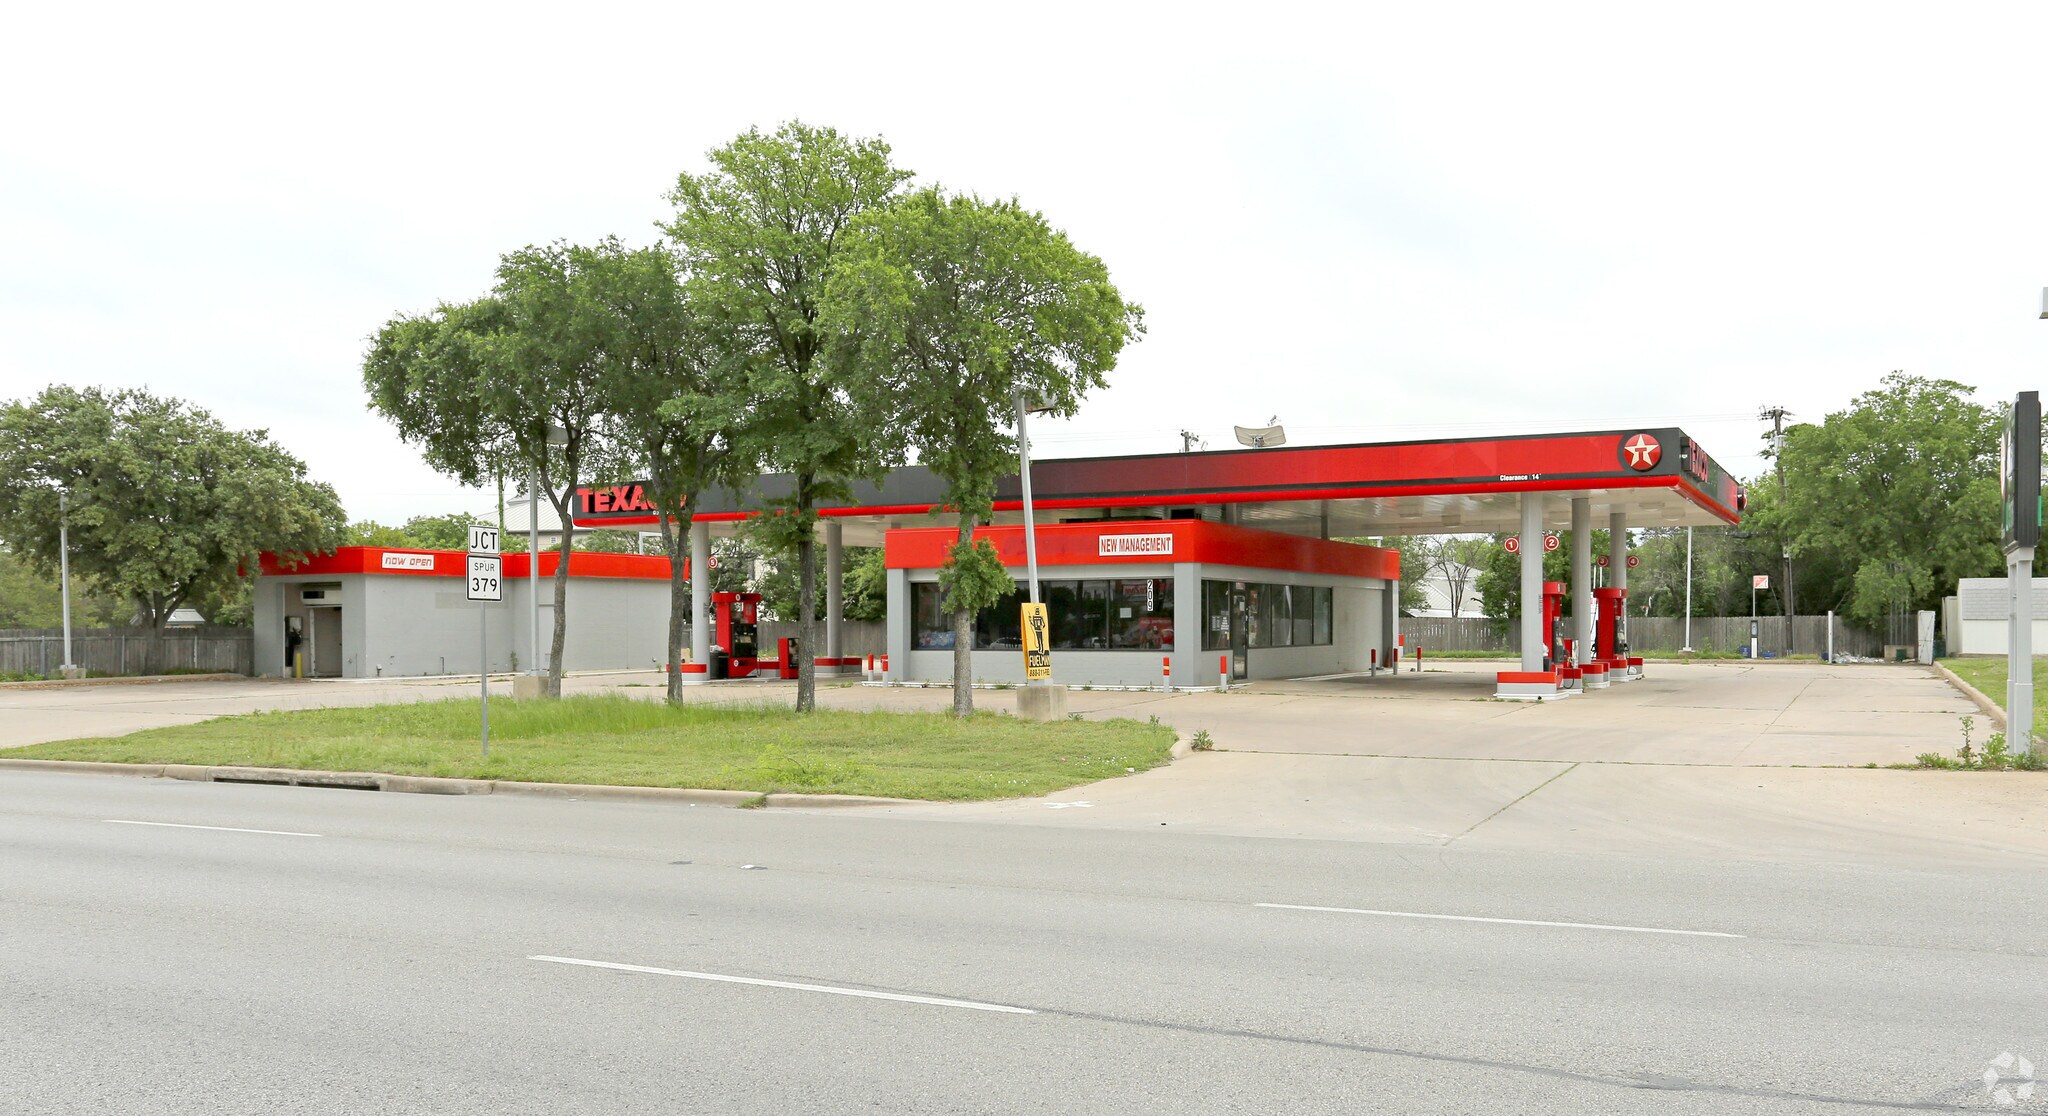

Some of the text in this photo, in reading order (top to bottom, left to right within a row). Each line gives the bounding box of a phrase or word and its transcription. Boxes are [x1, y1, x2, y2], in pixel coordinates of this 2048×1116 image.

[576, 485, 687, 513] TEXA
[471, 531, 497, 550] JCT
[1101, 537, 1171, 553] NEW MANAGEMENT
[474, 562, 495, 572] SPUR
[472, 577, 497, 592] 379
